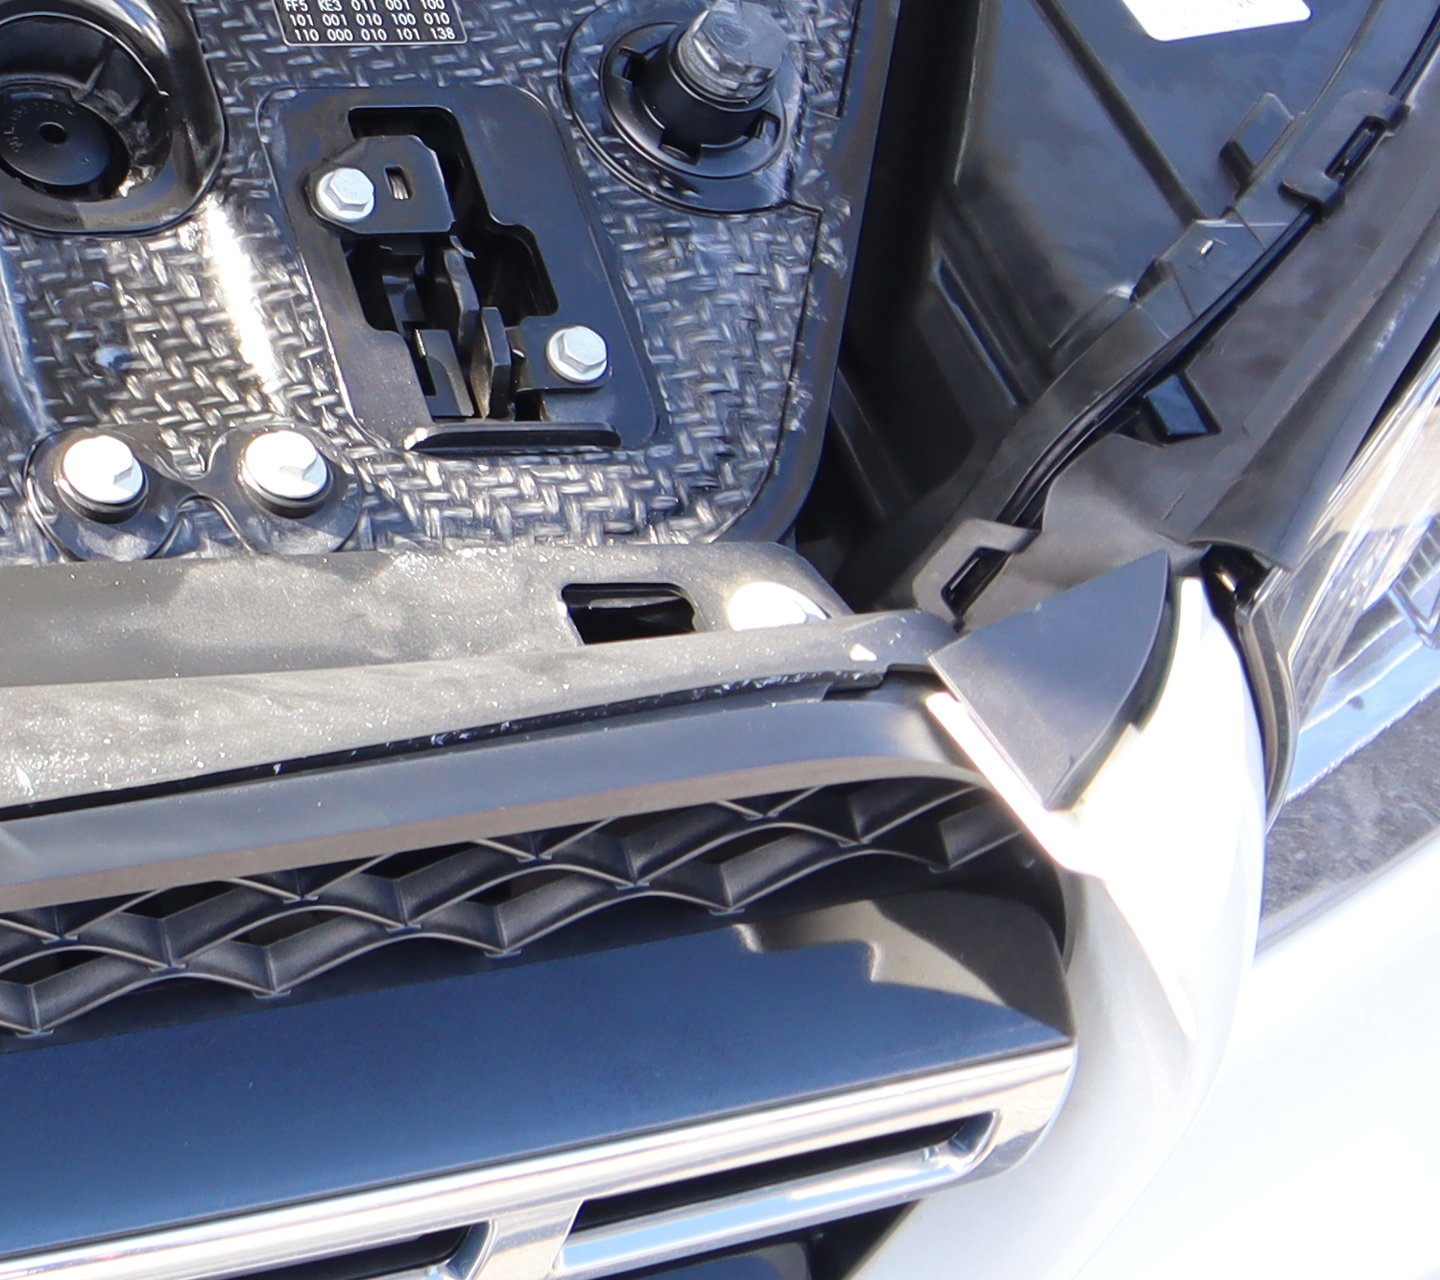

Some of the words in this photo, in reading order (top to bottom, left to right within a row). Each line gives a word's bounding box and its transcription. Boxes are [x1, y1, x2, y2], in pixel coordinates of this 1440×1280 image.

[290, 14, 314, 27] 101
[322, 14, 348, 26] 001
[356, 13, 382, 26] 010
[391, 13, 416, 26] 100
[424, 12, 450, 25] 010
[294, 29, 320, 42] 110
[327, 29, 353, 41] 000
[361, 28, 387, 41] 010
[396, 28, 421, 41] 101
[430, 27, 456, 40] 138
